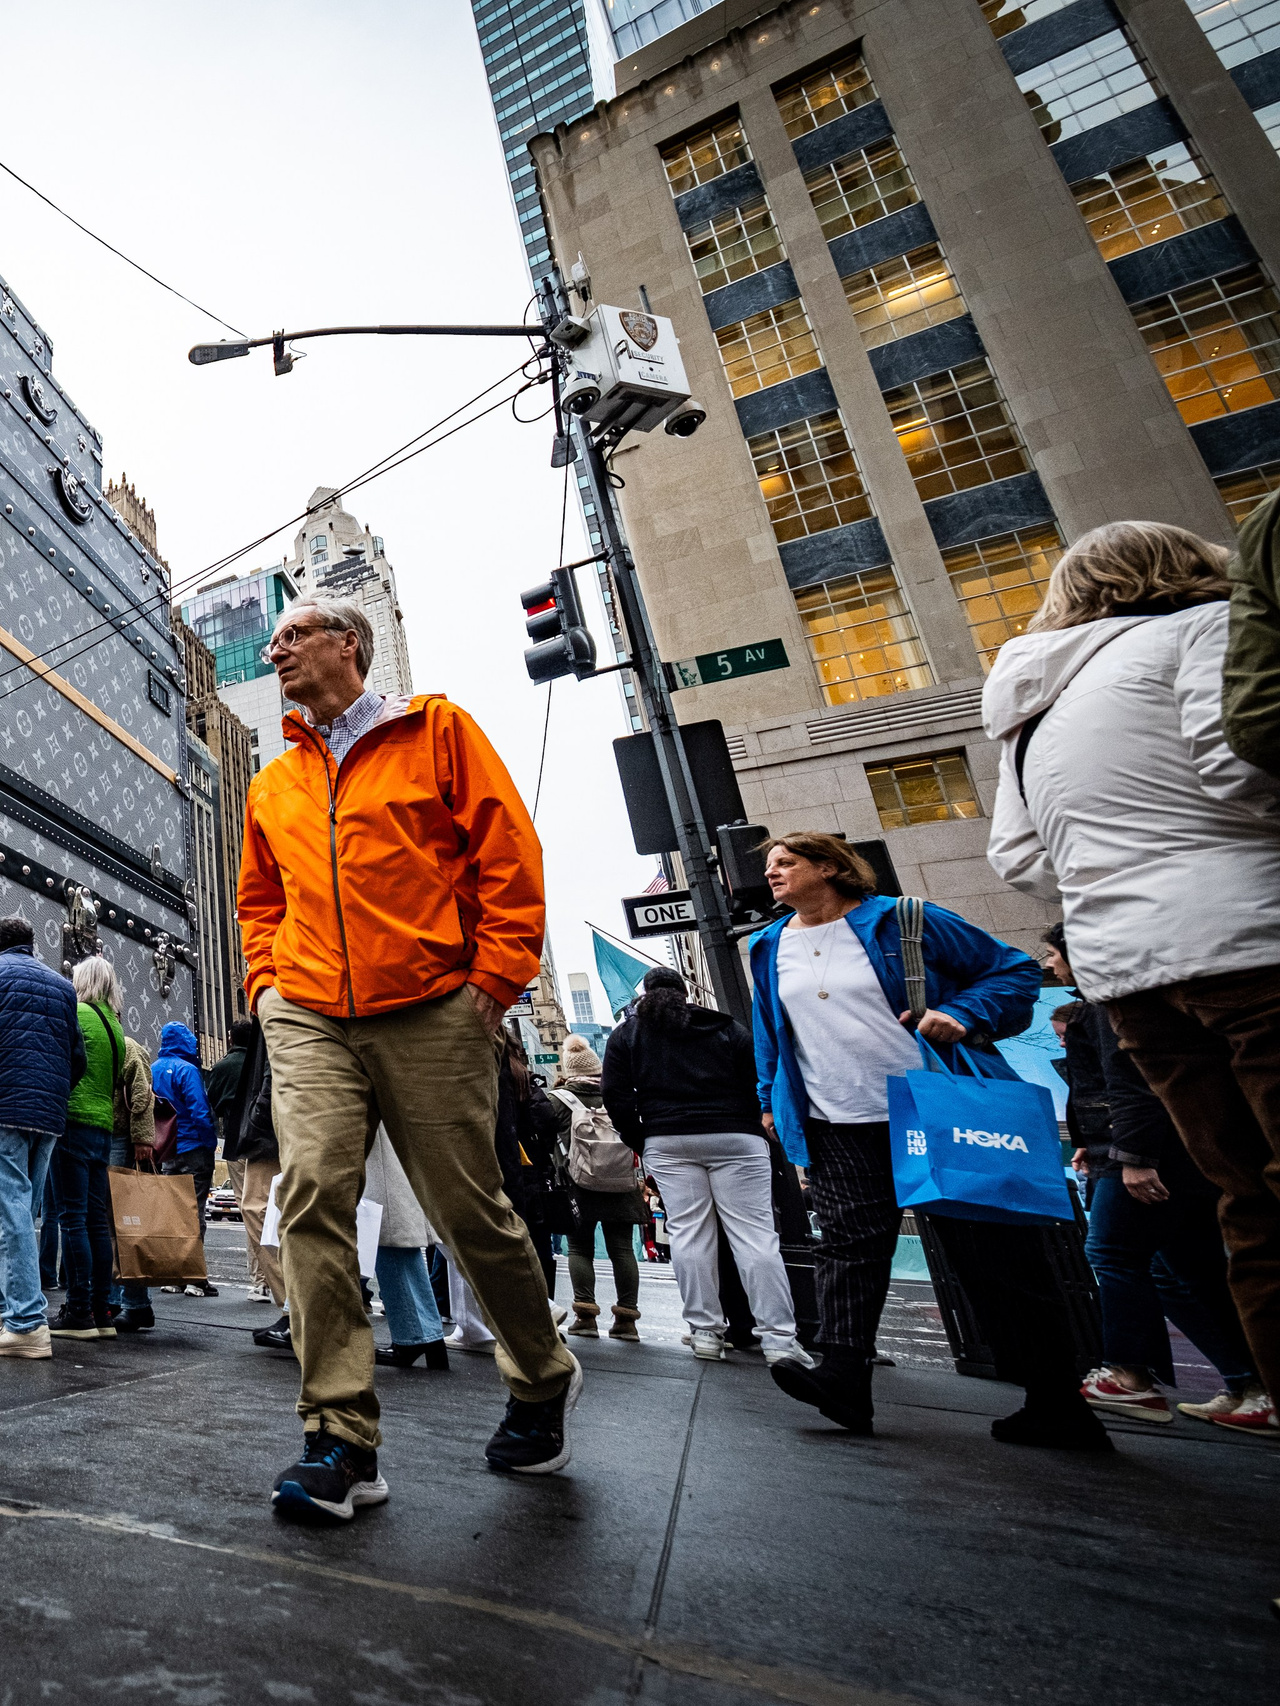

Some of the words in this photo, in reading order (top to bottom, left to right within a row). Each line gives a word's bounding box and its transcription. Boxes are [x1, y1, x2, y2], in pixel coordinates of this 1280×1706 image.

[633, 350, 664, 362] SECURITY
[640, 371, 668, 382] CAMERA
[717, 654, 732, 675] 5
[644, 903, 690, 923] ONE
[539, 1055, 544, 1063] 5
[953, 1127, 1029, 1153] HOKA
[907, 1146, 927, 1155] FLY
